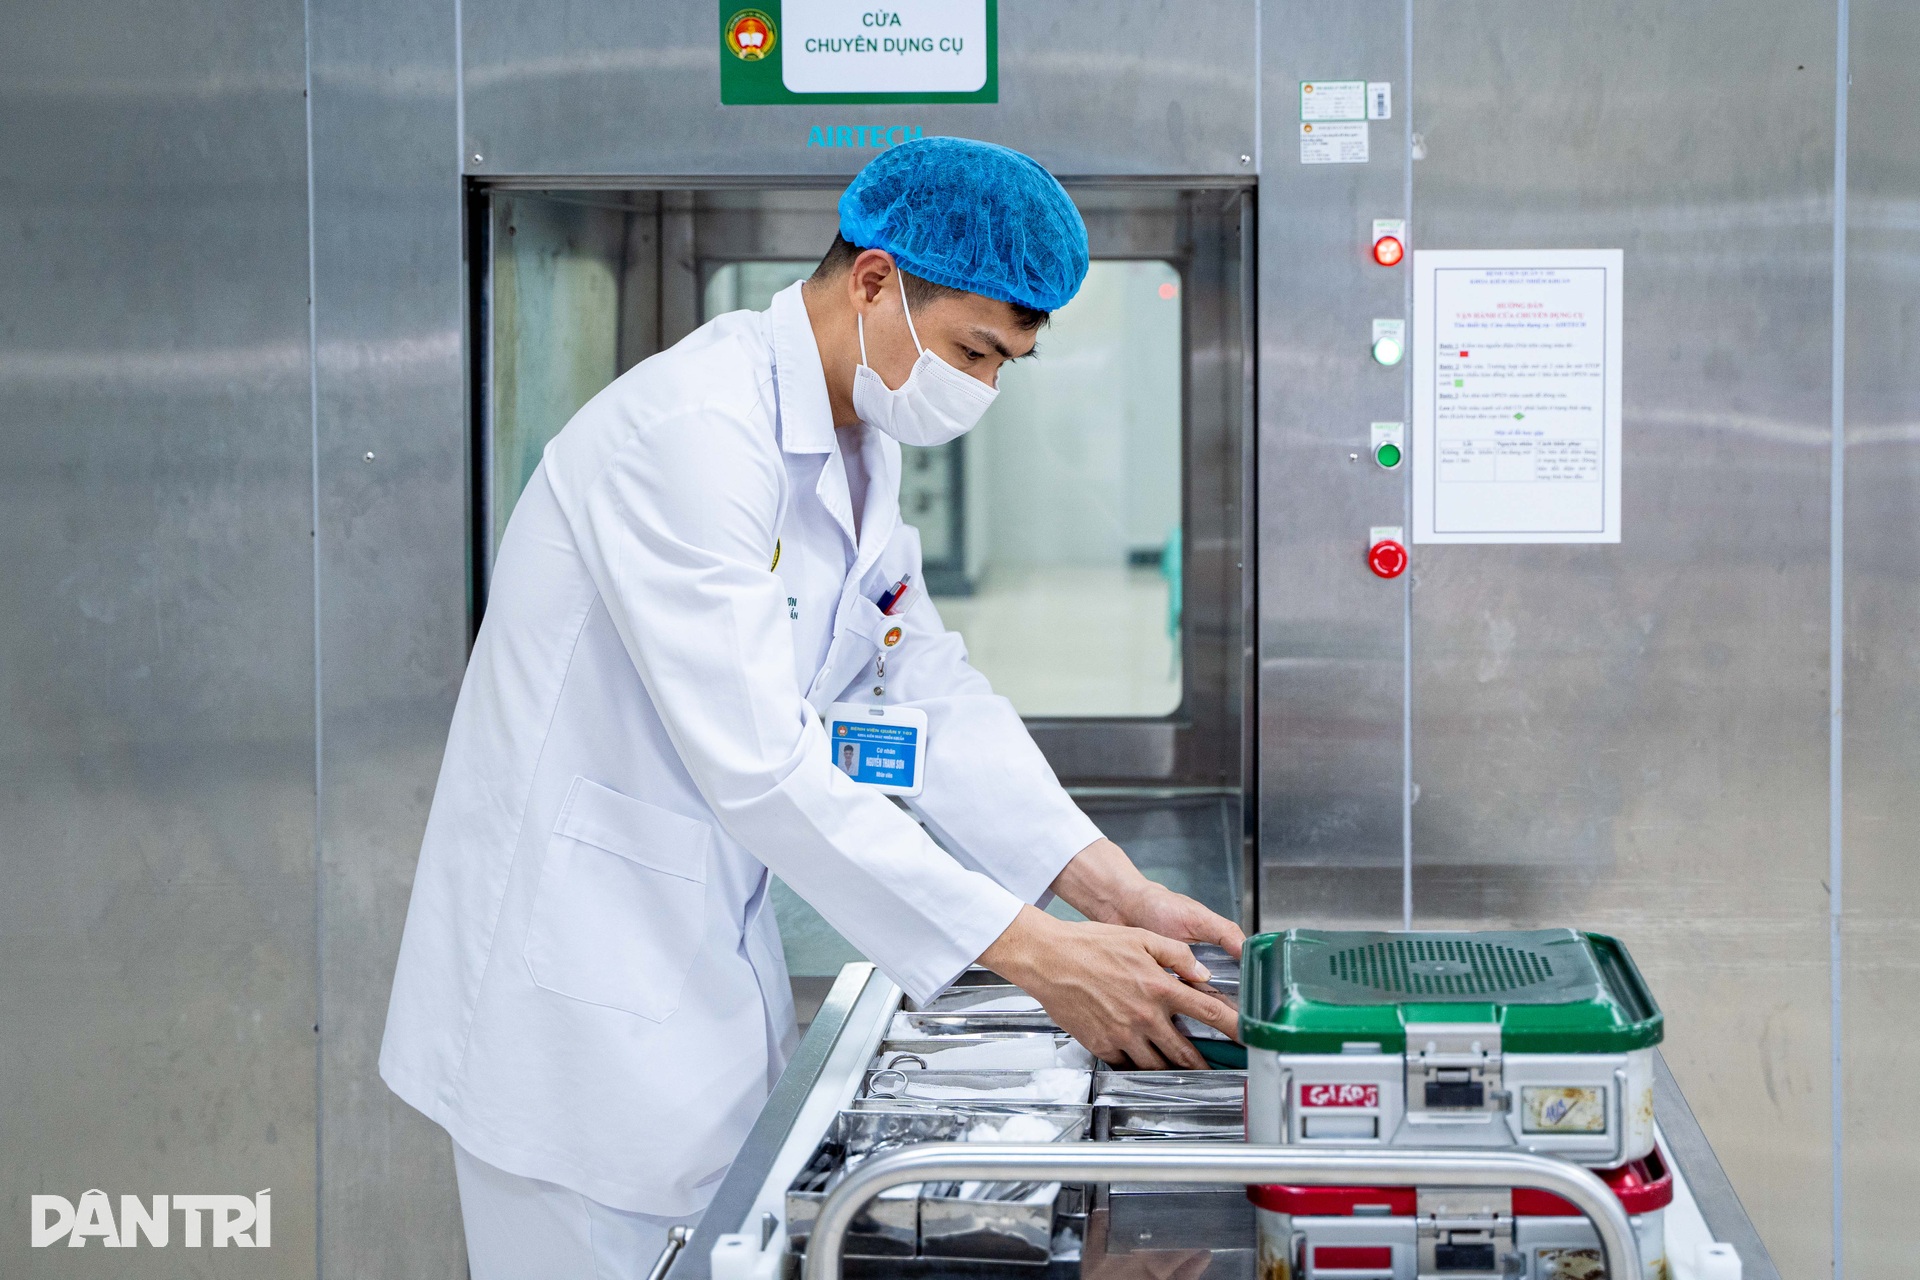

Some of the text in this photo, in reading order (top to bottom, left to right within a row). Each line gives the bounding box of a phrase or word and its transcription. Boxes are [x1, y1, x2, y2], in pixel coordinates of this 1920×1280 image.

[862, 9, 902, 27] CỬA
[805, 34, 963, 56] CHUYÊN DỤNG CỤ
[807, 125, 924, 148] AIRTECH
